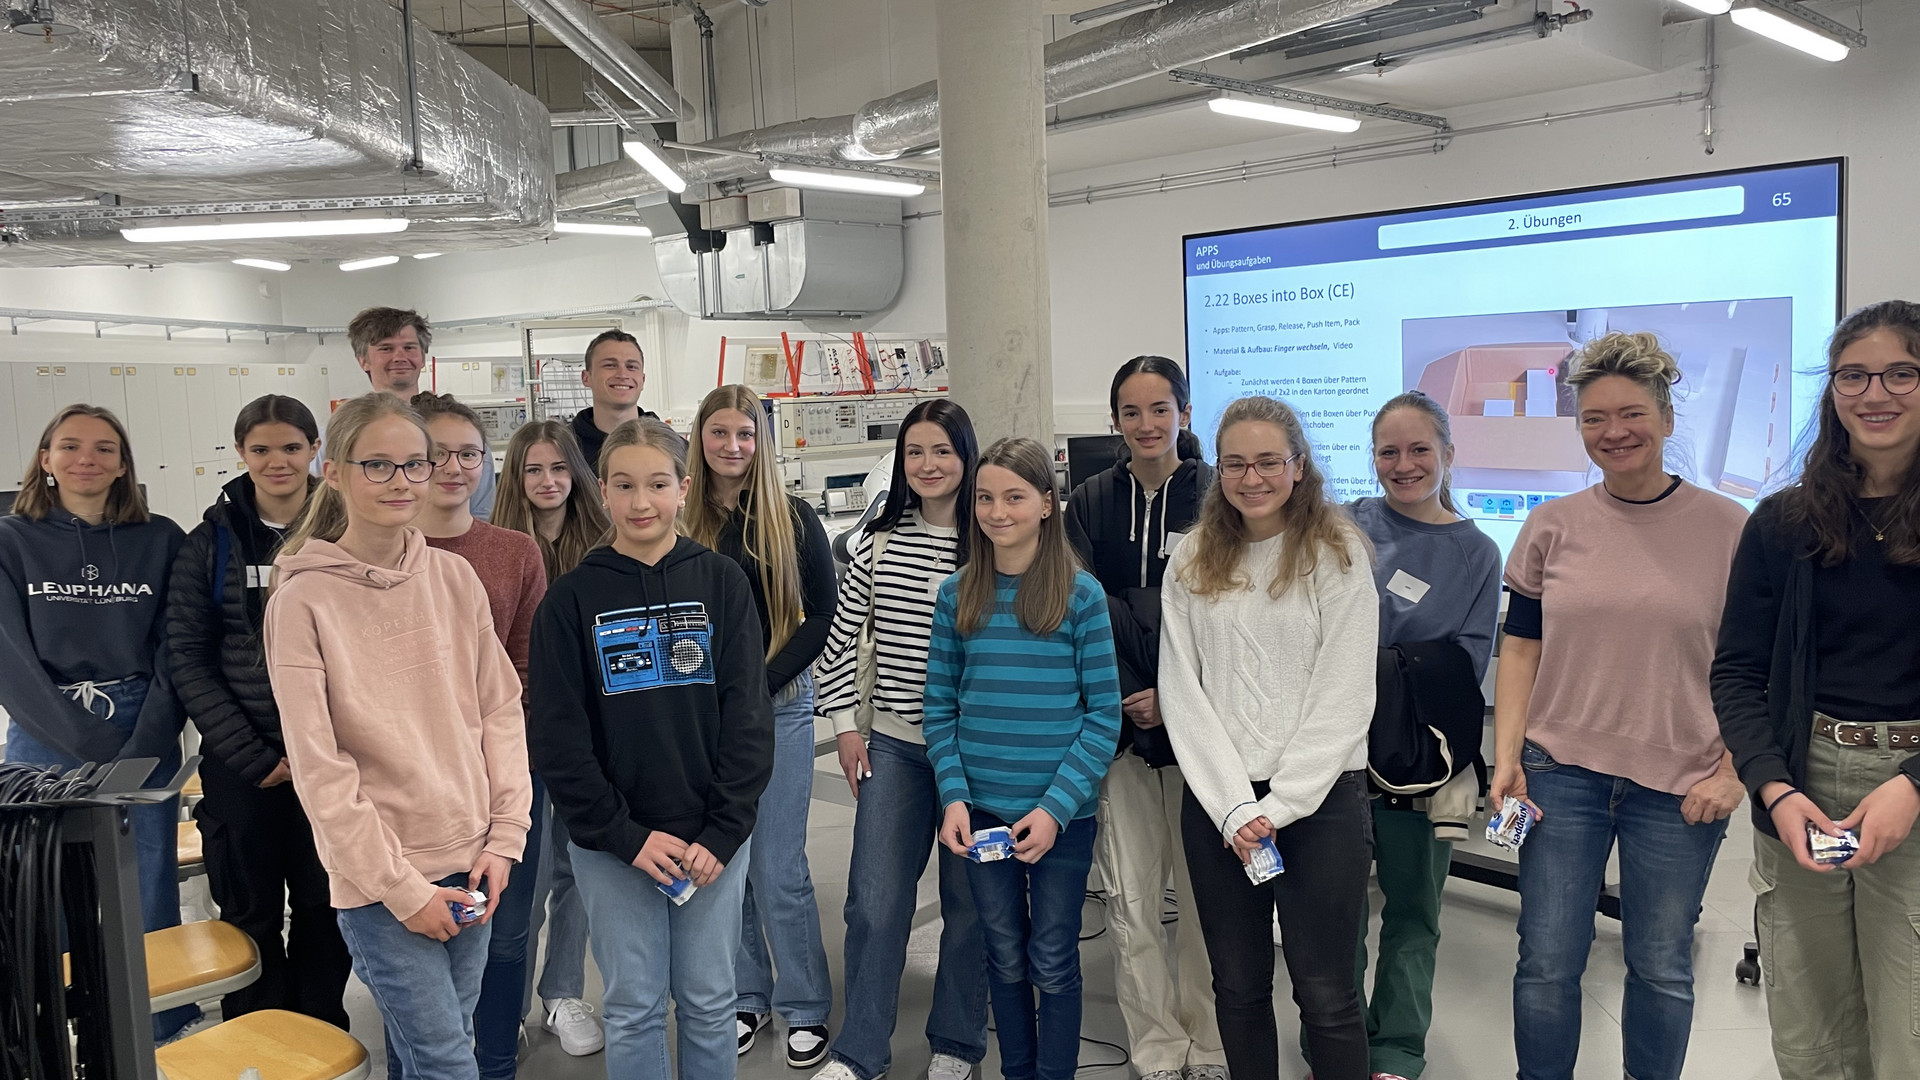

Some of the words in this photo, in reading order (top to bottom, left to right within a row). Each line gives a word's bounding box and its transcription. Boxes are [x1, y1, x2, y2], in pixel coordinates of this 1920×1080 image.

[1772, 193, 1791, 206] 65
[1508, 218, 1519, 230] 2.
[1523, 213, 1582, 229] Übungen
[1195, 244, 1219, 257] APPS
[1196, 261, 1210, 270] und
[1211, 256, 1271, 270] Übungsaufgaben
[1204, 293, 1230, 307] 2.22
[1233, 292, 1268, 305] Boxes
[1271, 289, 1296, 302] into
[1300, 287, 1324, 301] Box
[1328, 282, 1355, 301] (CE)
[1212, 326, 1231, 335] Apps:
[1231, 325, 1256, 333] Pattern,
[1256, 323, 1278, 332] Grasp,
[1278, 321, 1306, 331] Release,
[1307, 320, 1323, 329] Push
[1324, 319, 1343, 328] Item,
[1344, 318, 1360, 327] Pack
[1213, 346, 1240, 355] Material
[1240, 346, 1247, 354] &
[1247, 345, 1273, 354] Aufbau:
[1274, 344, 1295, 354] Finger
[1296, 343, 1330, 352] wechseln,
[1333, 341, 1353, 350] Video
[1214, 368, 1242, 378] Aufgabe:
[1241, 378, 1269, 386] Zunächst
[1270, 377, 1295, 386] werden
[1296, 377, 1301, 385] 4
[1301, 376, 1323, 385] Boxen
[1324, 376, 1340, 384] über
[1341, 375, 1367, 384] Pattern
[1254, 388, 1266, 397] 1x4
[1267, 388, 1278, 396] auf
[1278, 388, 1290, 396] 2x2
[1291, 388, 1299, 396] in
[1299, 388, 1313, 396] den
[1313, 387, 1336, 396] Karton
[1337, 387, 1369, 397] geordnet
[1311, 410, 1322, 418] die
[1323, 409, 1344, 417] Boxen
[1345, 409, 1361, 417] über
[1302, 421, 1334, 429] eschoben
[1331, 443, 1348, 451] über
[1349, 443, 1361, 451] ein
[1350, 477, 1366, 485] über
[1350, 487, 1372, 496] indem
[28, 581, 153, 597] LEUPHANA
